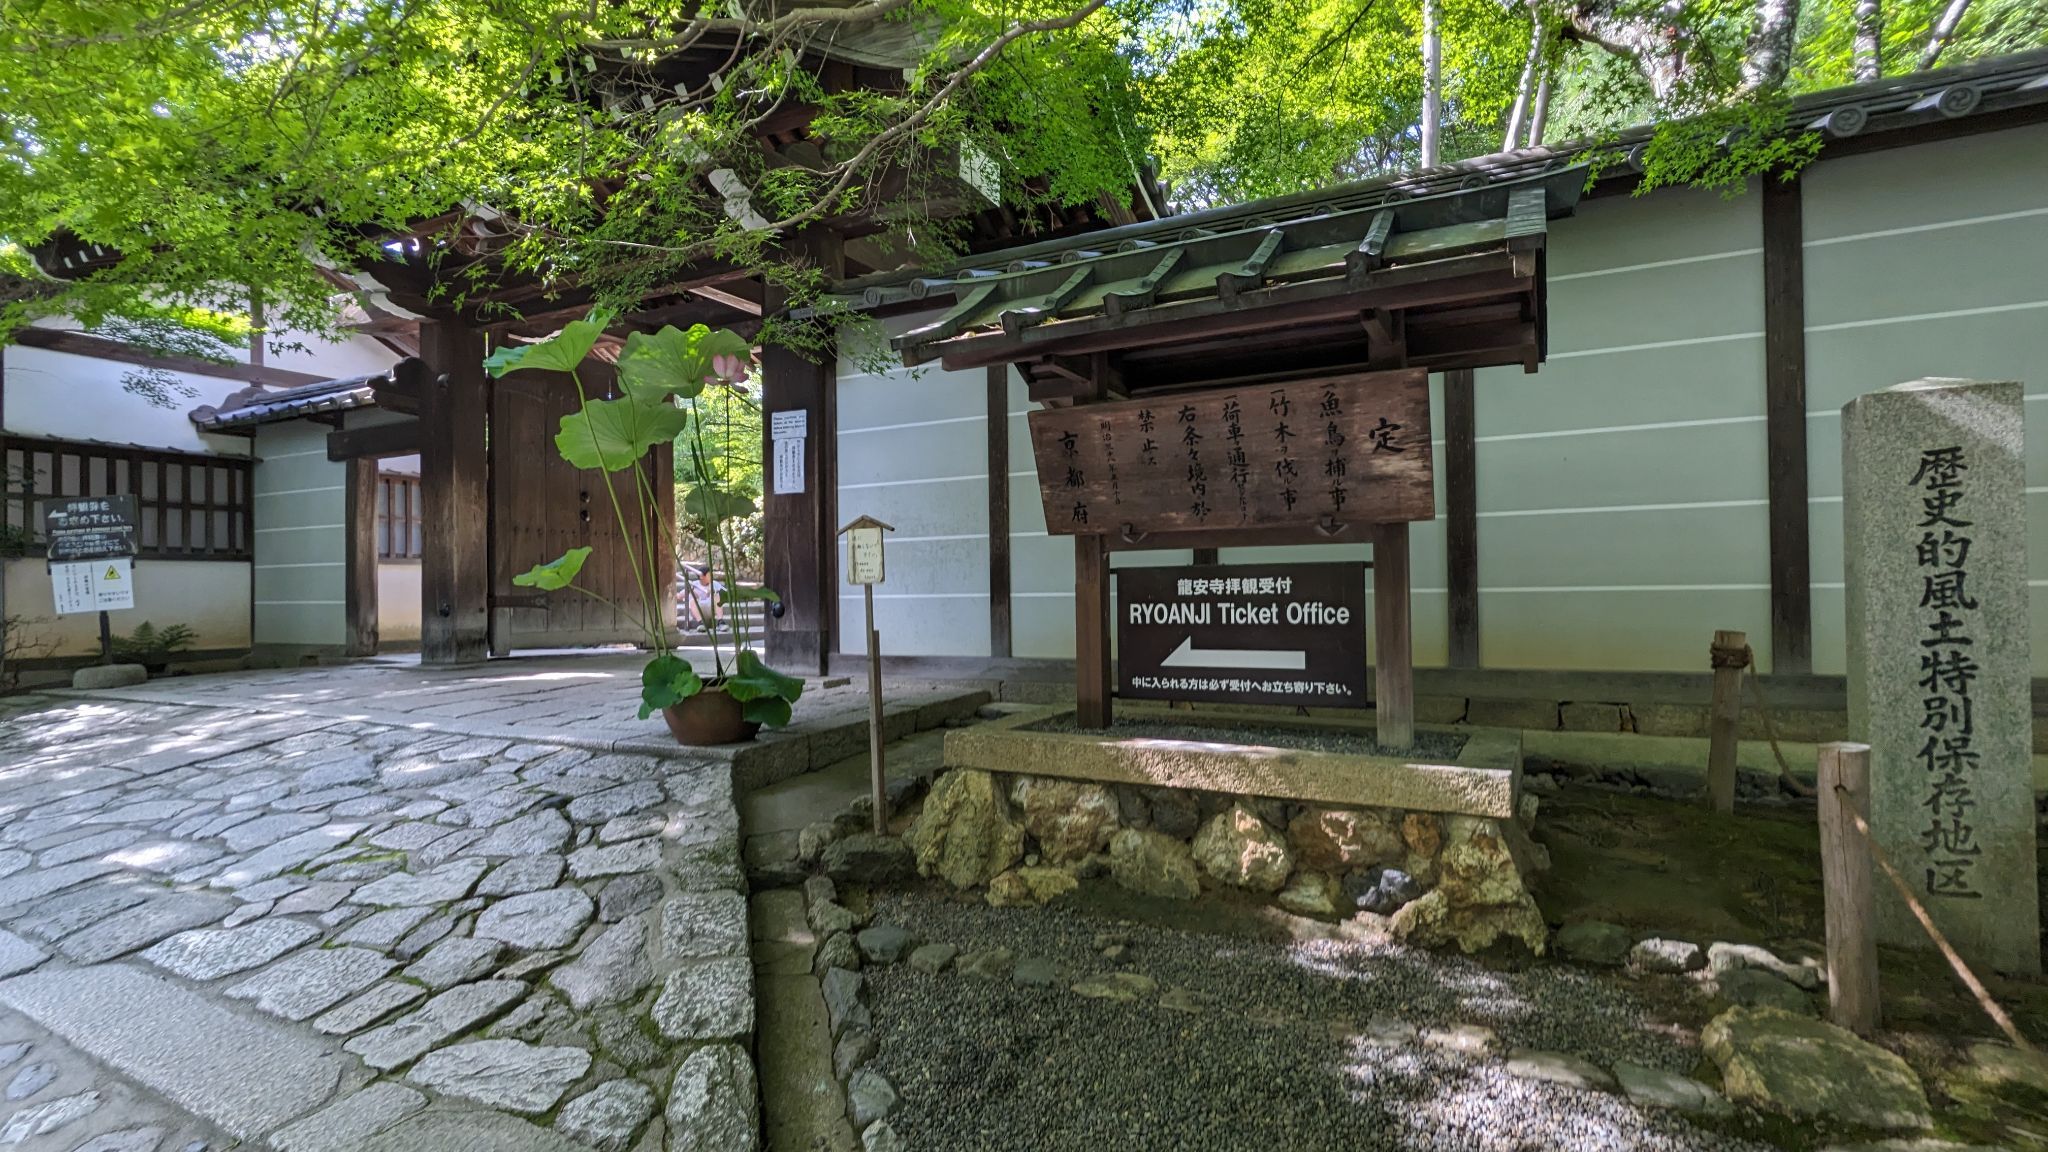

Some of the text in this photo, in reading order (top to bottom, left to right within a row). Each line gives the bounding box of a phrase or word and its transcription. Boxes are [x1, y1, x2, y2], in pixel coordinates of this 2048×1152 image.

[1369, 417, 1406, 454] 定
[1058, 430, 1088, 524] 京都府
[1177, 577, 1292, 596] 龍安寺拝観受付
[1129, 602, 1350, 625] RYOANJI Ticket Office
[1909, 446, 1982, 898] 歴史的風土特別保存地区
